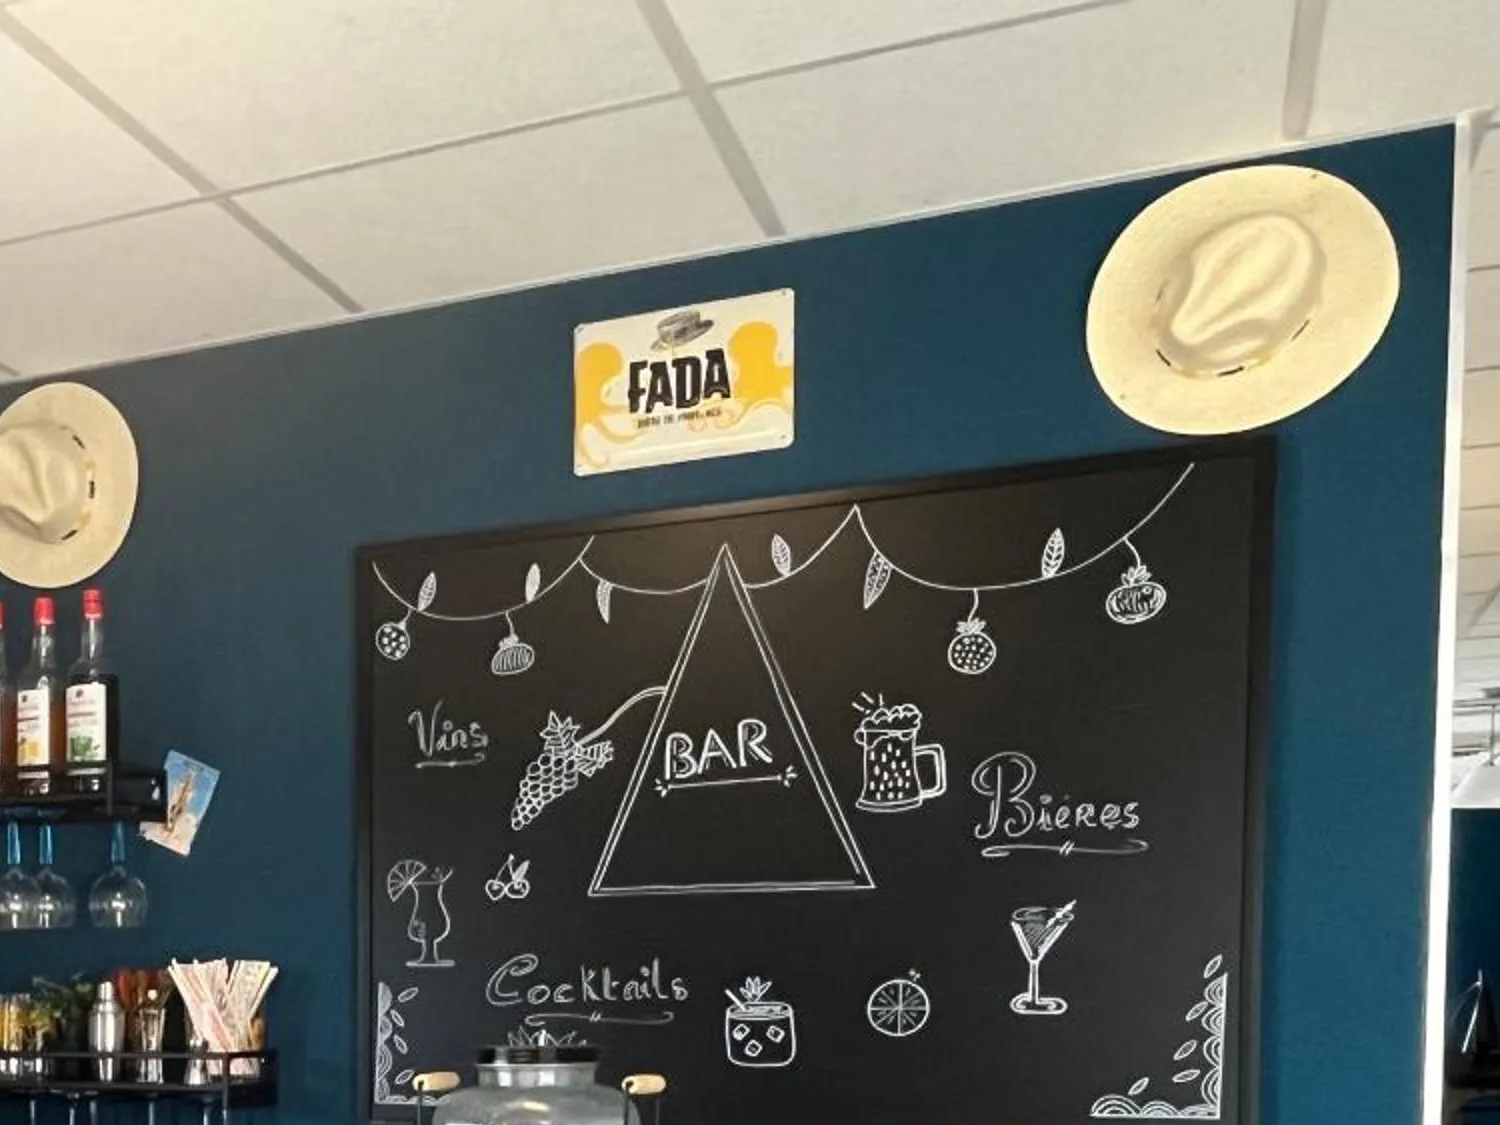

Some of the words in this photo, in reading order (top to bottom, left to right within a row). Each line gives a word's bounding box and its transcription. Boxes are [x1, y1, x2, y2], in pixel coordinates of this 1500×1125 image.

[627, 348, 731, 413] FADA
[407, 699, 489, 757] Vins
[664, 718, 773, 780] BAR
[485, 953, 689, 1007] Cocktails
